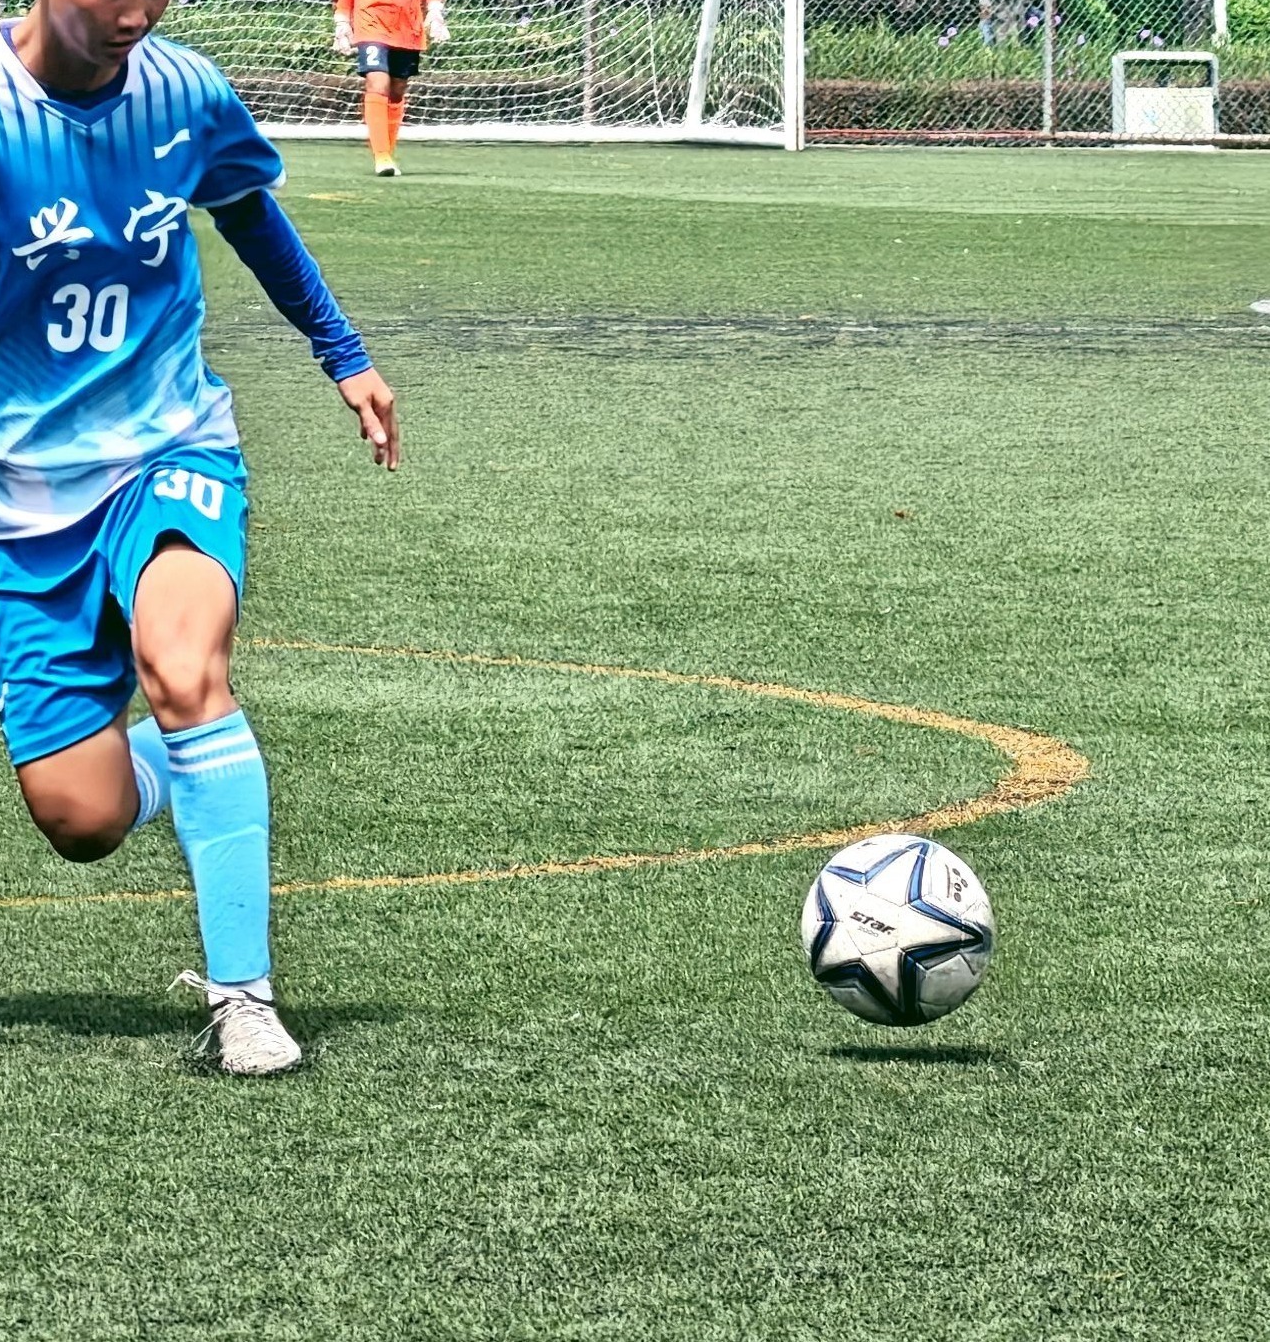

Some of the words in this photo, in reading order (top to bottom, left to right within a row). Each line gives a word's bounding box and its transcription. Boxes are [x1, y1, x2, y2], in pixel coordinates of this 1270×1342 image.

[365, 45, 379, 66] 2
[12, 189, 189, 270] 兴宁
[46, 283, 129, 353] 30
[153, 468, 224, 521] 30
